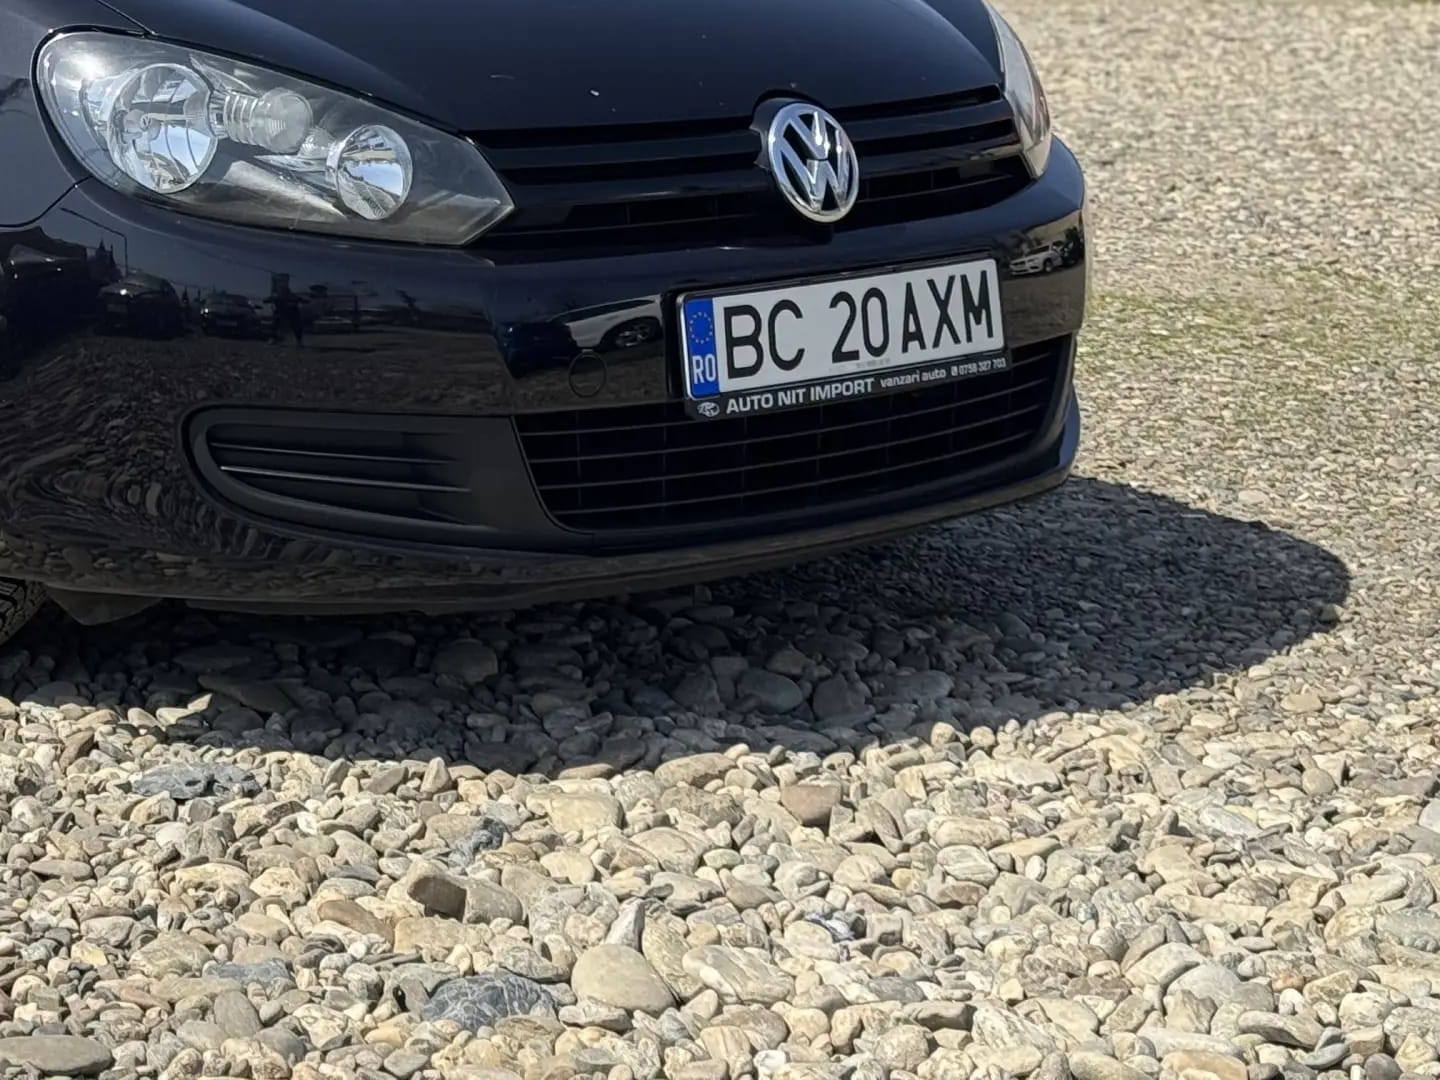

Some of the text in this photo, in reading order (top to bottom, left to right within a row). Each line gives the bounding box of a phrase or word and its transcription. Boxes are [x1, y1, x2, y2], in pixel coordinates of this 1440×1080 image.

[723, 298, 806, 380] BC
[692, 353, 717, 385] RO
[726, 393, 774, 414] AUTO
[778, 388, 806, 407] NIT
[810, 378, 875, 402] IMPORT
[880, 370, 921, 388] vanzari
[922, 368, 947, 382] auto
